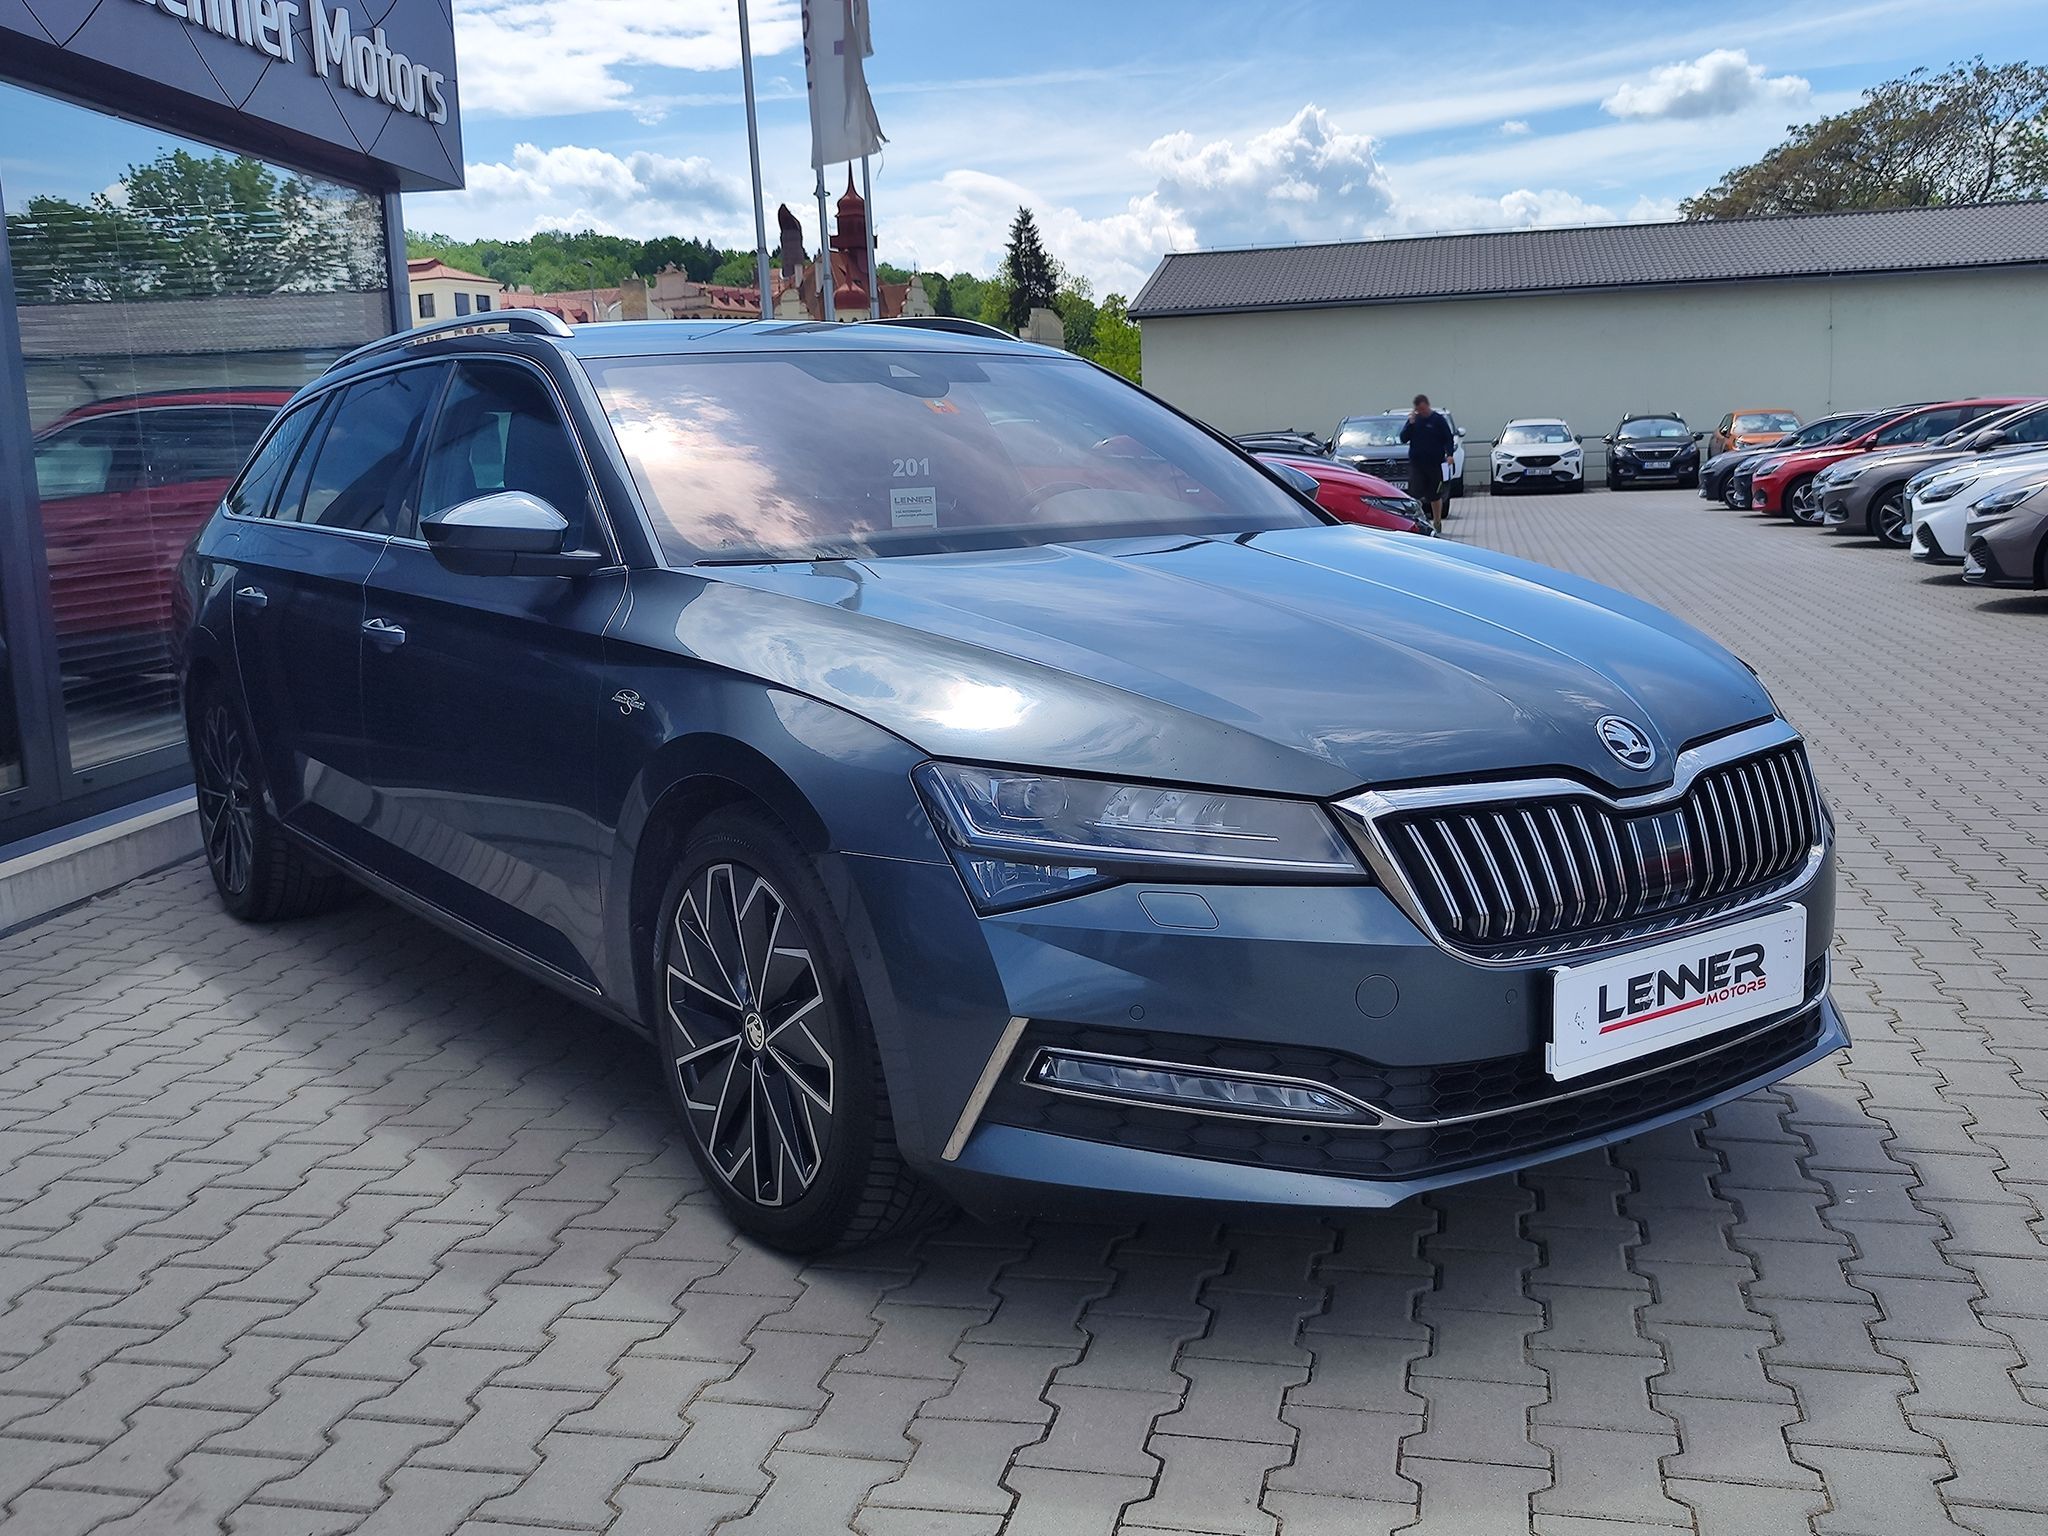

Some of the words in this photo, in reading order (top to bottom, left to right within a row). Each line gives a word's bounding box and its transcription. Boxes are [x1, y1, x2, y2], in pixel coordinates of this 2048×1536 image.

[134, 0, 299, 64] nner
[309, 0, 448, 125] Motors
[892, 457, 930, 477] 201
[894, 495, 933, 504] LENNER
[1599, 943, 1766, 1023] LENNER
[1706, 977, 1767, 1006] MOTORS
